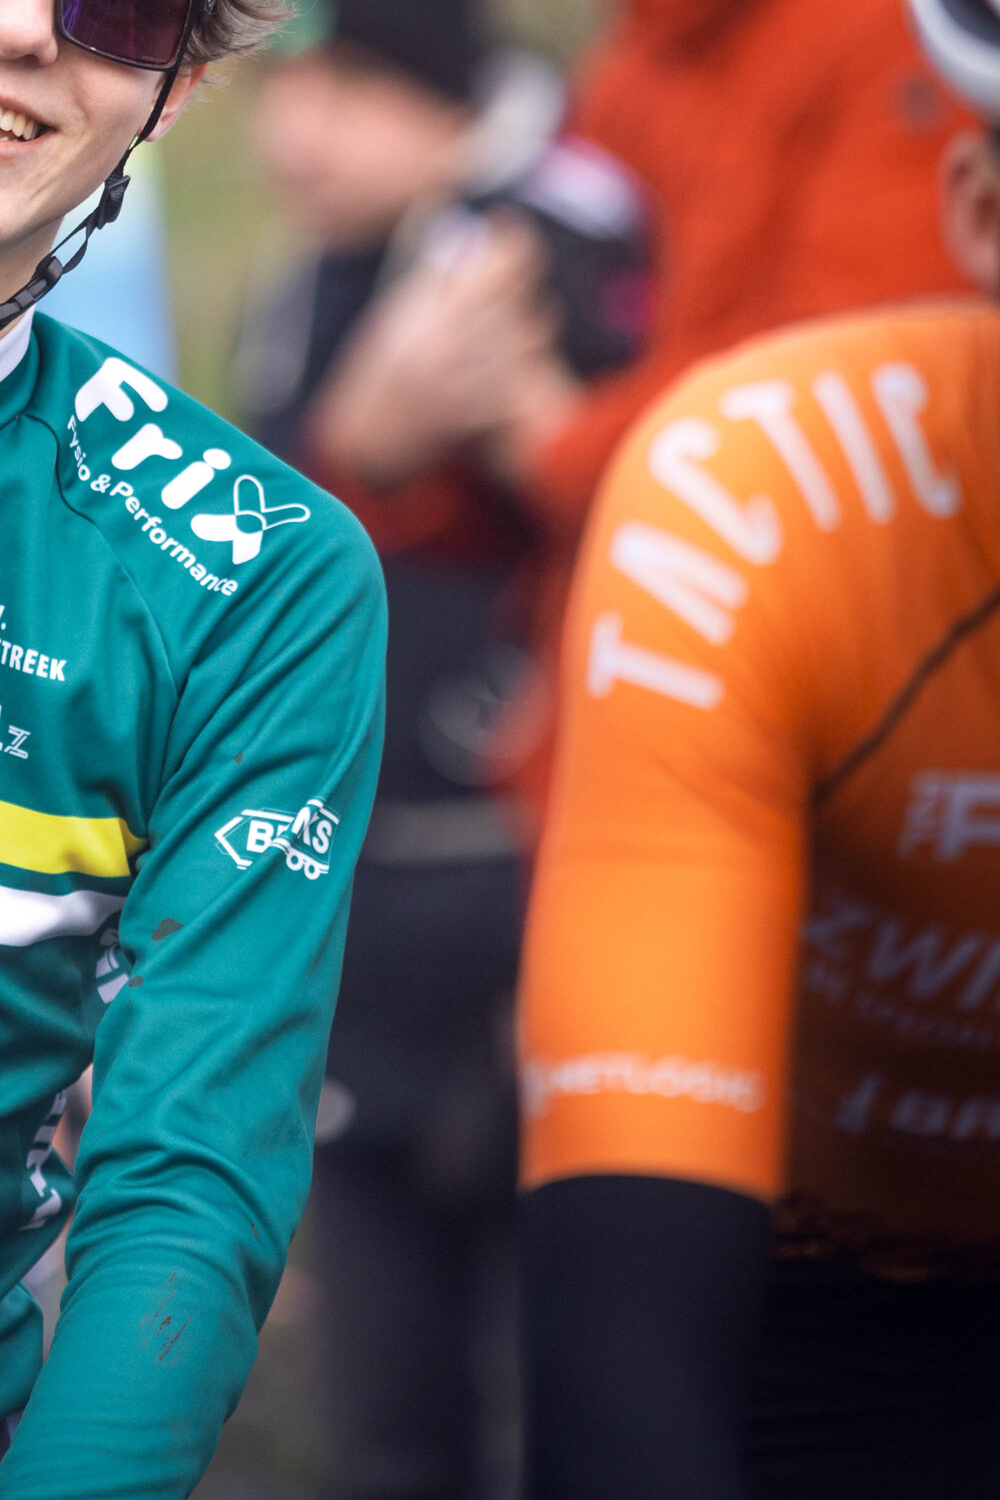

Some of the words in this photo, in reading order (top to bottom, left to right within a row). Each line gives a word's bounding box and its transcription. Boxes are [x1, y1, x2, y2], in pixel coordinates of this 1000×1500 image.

[67, 415, 91, 481] Fysio
[90, 474, 111, 493] &
[109, 481, 239, 596] Performance
[587, 362, 964, 711] TACTIC
